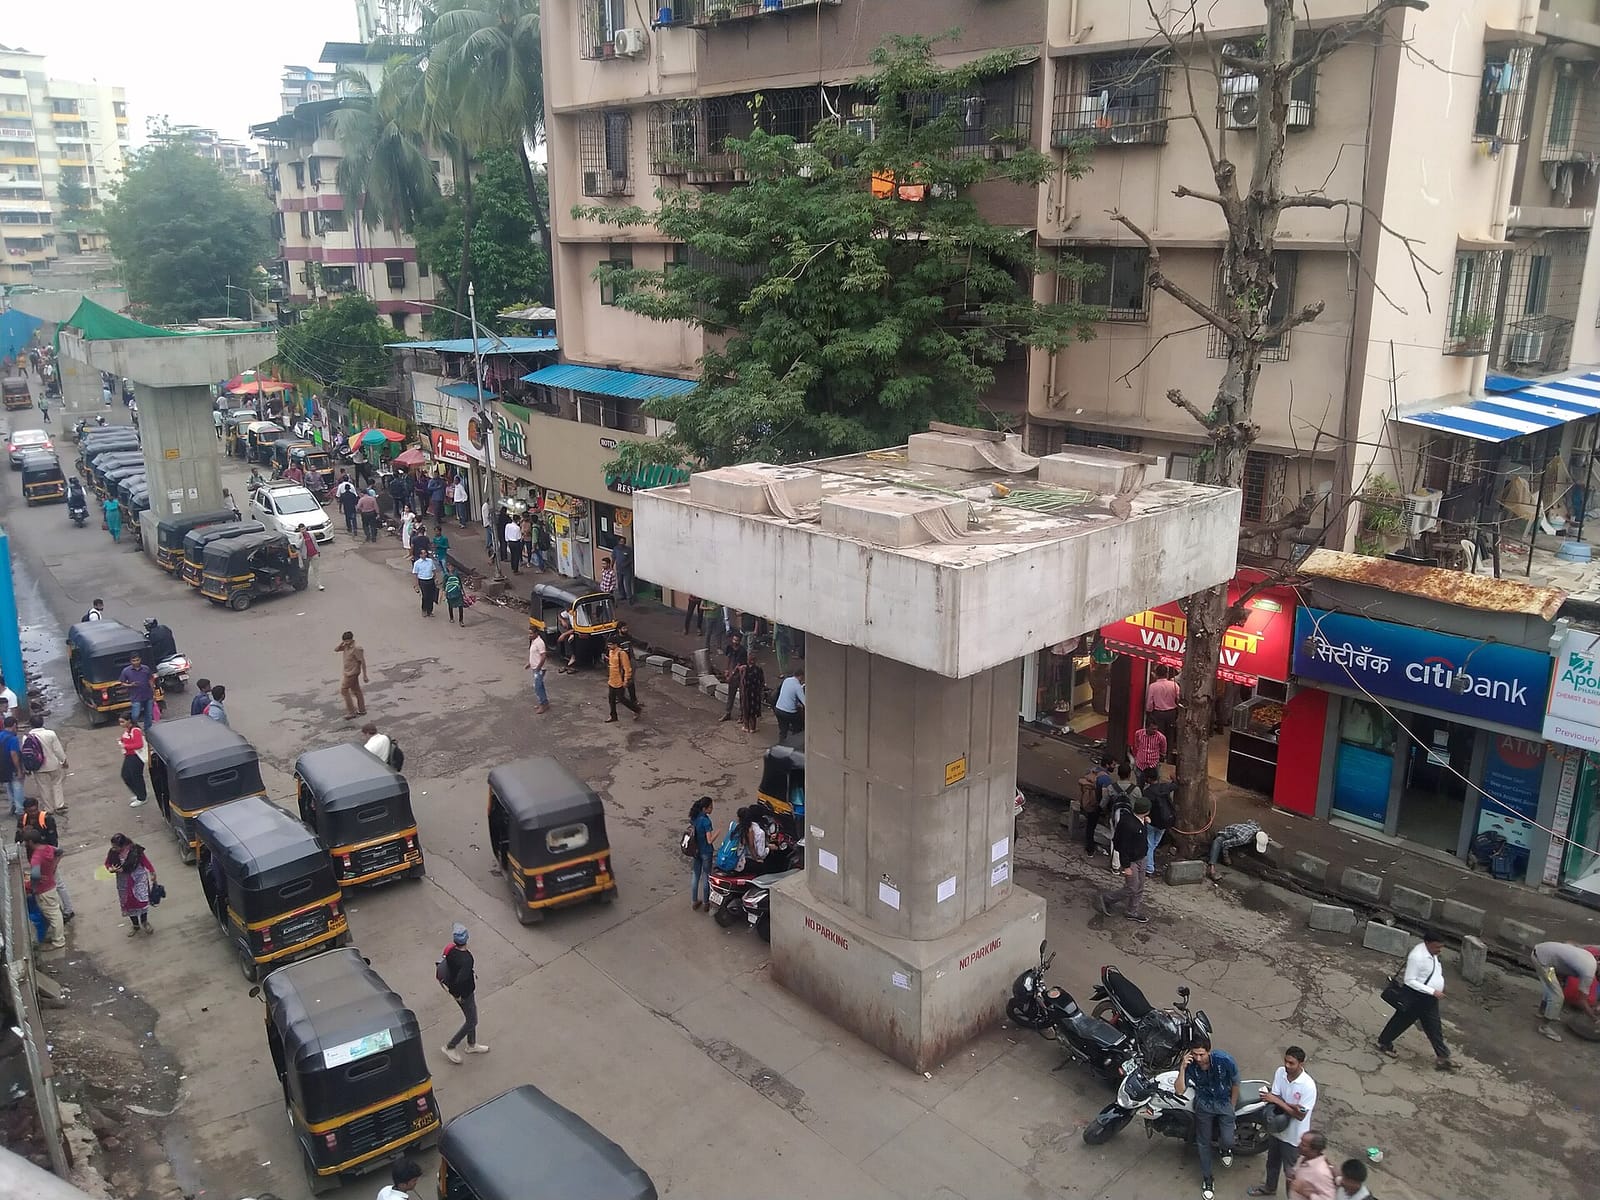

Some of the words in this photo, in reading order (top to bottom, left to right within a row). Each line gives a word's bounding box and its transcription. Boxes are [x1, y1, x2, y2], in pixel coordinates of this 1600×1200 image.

[1501, 736, 1541, 757] ATM
[1555, 727, 1599, 745] Previously
[805, 916, 815, 930] NO
[816, 922, 848, 950] PARKING
[959, 955, 970, 970] NO
[970, 937, 1001, 965] PARKING
